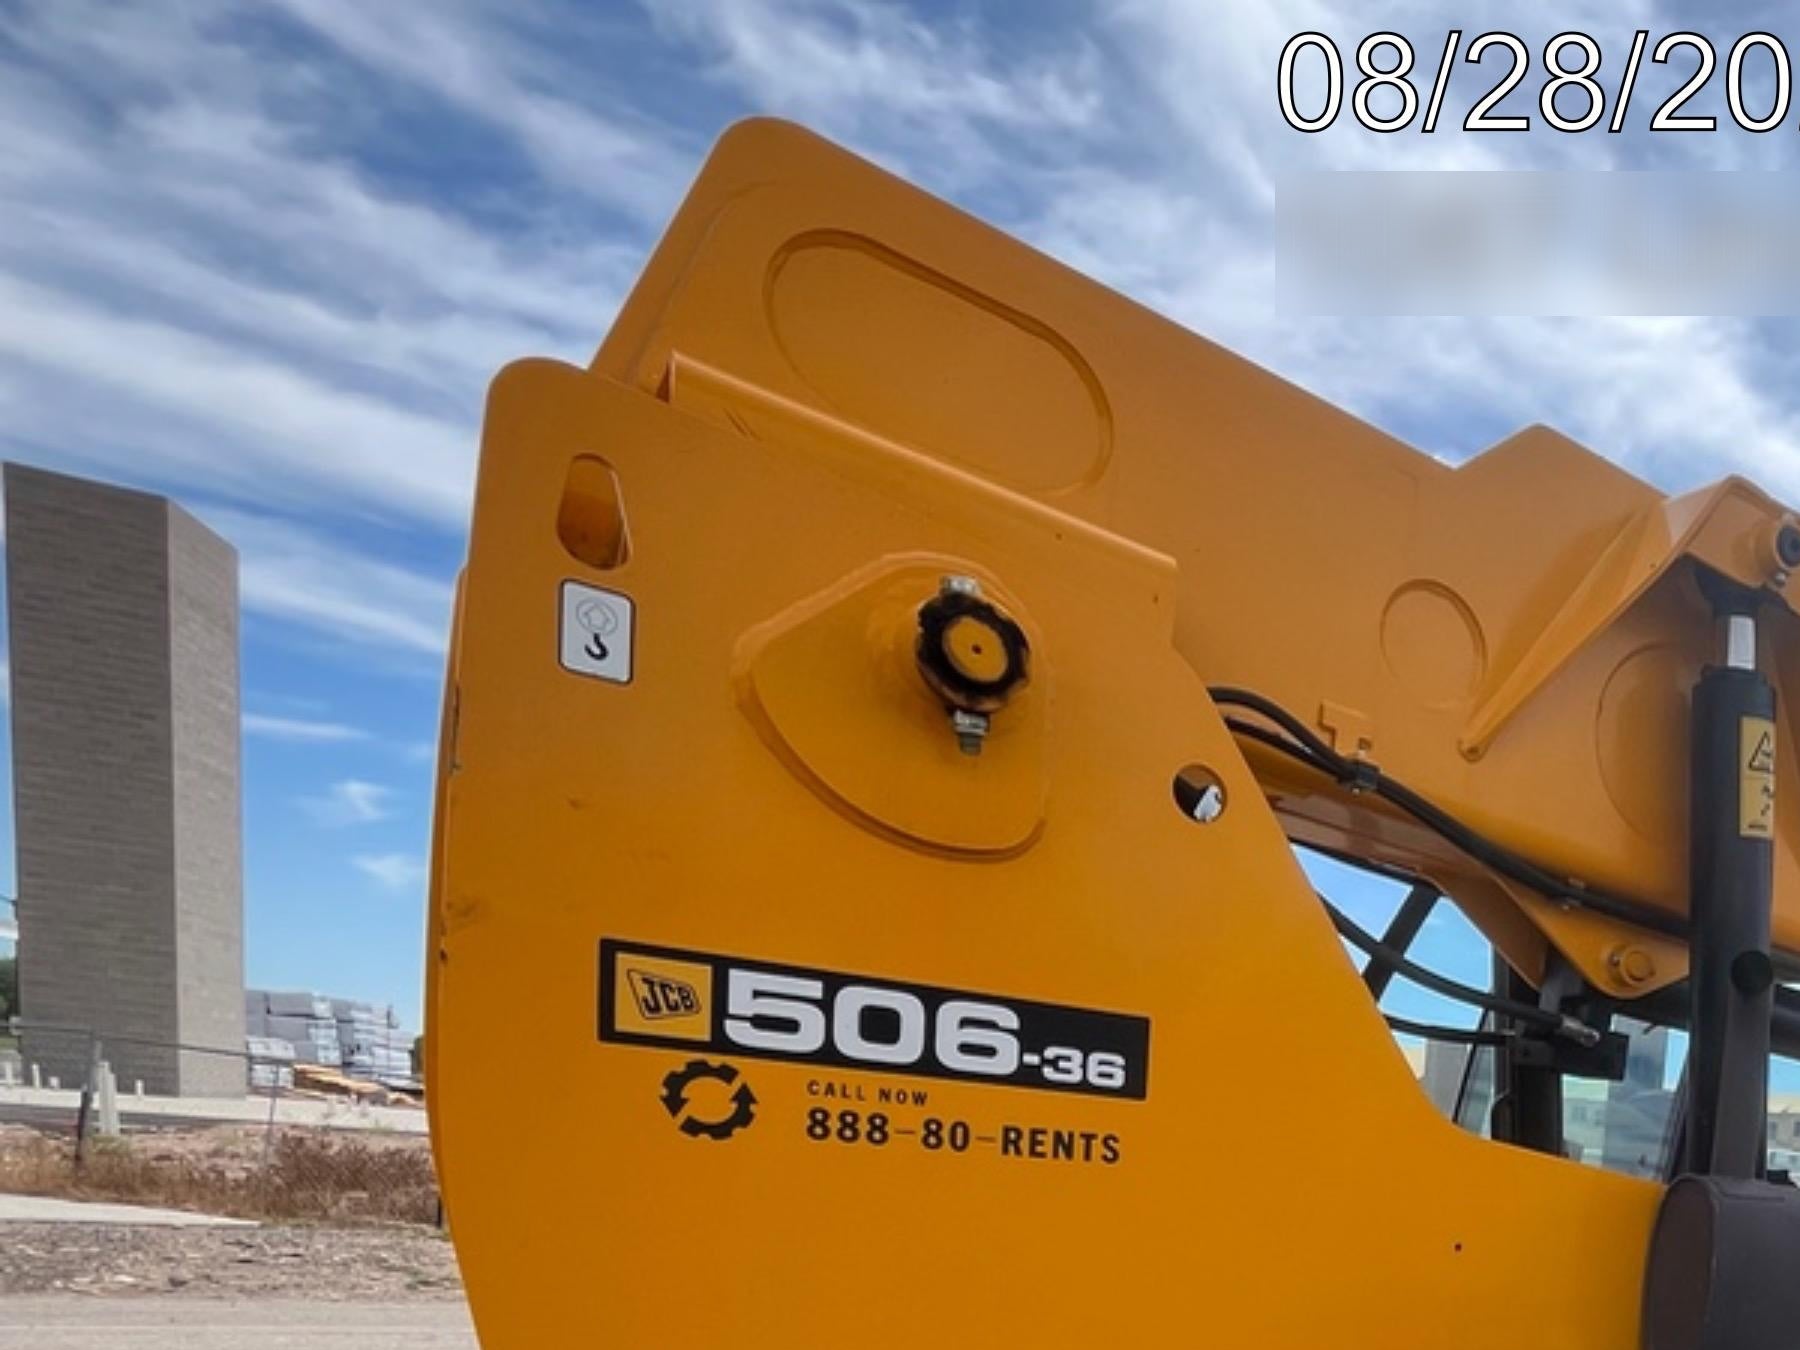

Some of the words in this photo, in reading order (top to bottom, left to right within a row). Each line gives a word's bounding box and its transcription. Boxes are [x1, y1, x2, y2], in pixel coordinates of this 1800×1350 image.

[640, 976, 695, 1014] JCB
[724, 967, 1126, 1090] 506-36
[806, 1079, 866, 1101] CALL
[878, 1088, 928, 1106] NOW
[806, 1106, 1121, 1164] 888-80-RENTS
